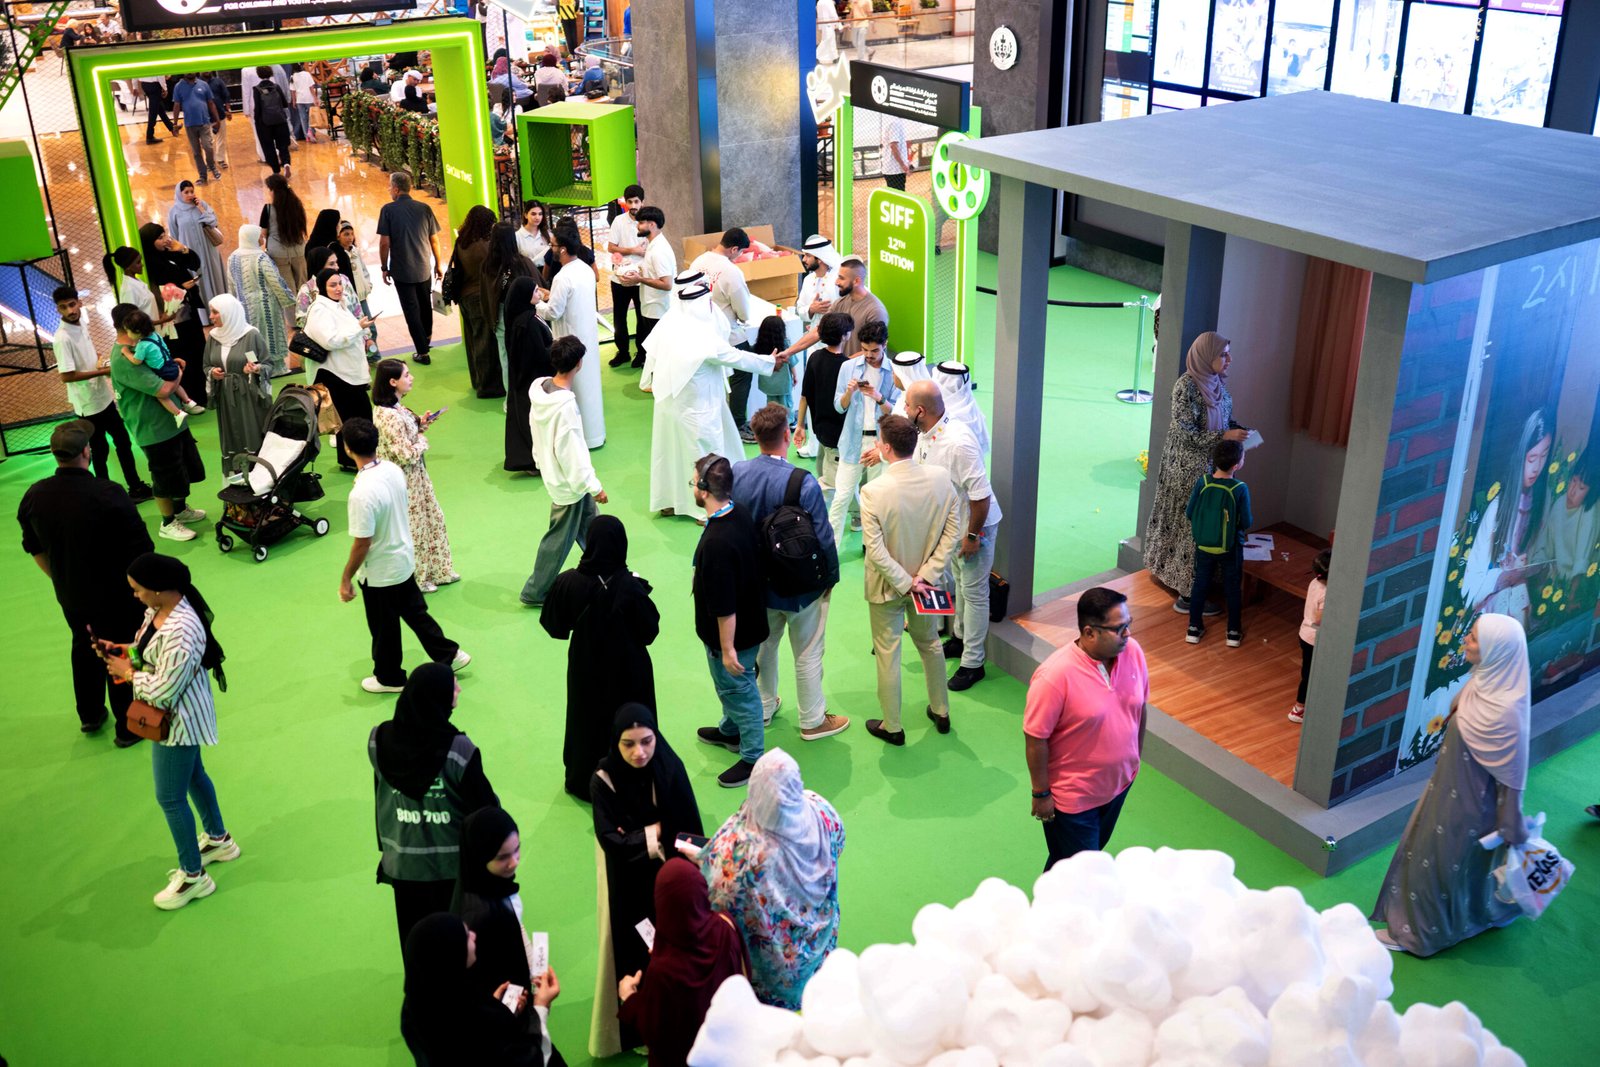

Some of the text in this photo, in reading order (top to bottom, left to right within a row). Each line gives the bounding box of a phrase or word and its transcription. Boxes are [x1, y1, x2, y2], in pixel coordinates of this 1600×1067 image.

[880, 200, 915, 230] SIFF
[888, 236, 906, 251] 12TH
[880, 250, 915, 272] EDITION
[396, 807, 451, 825] 800 700
